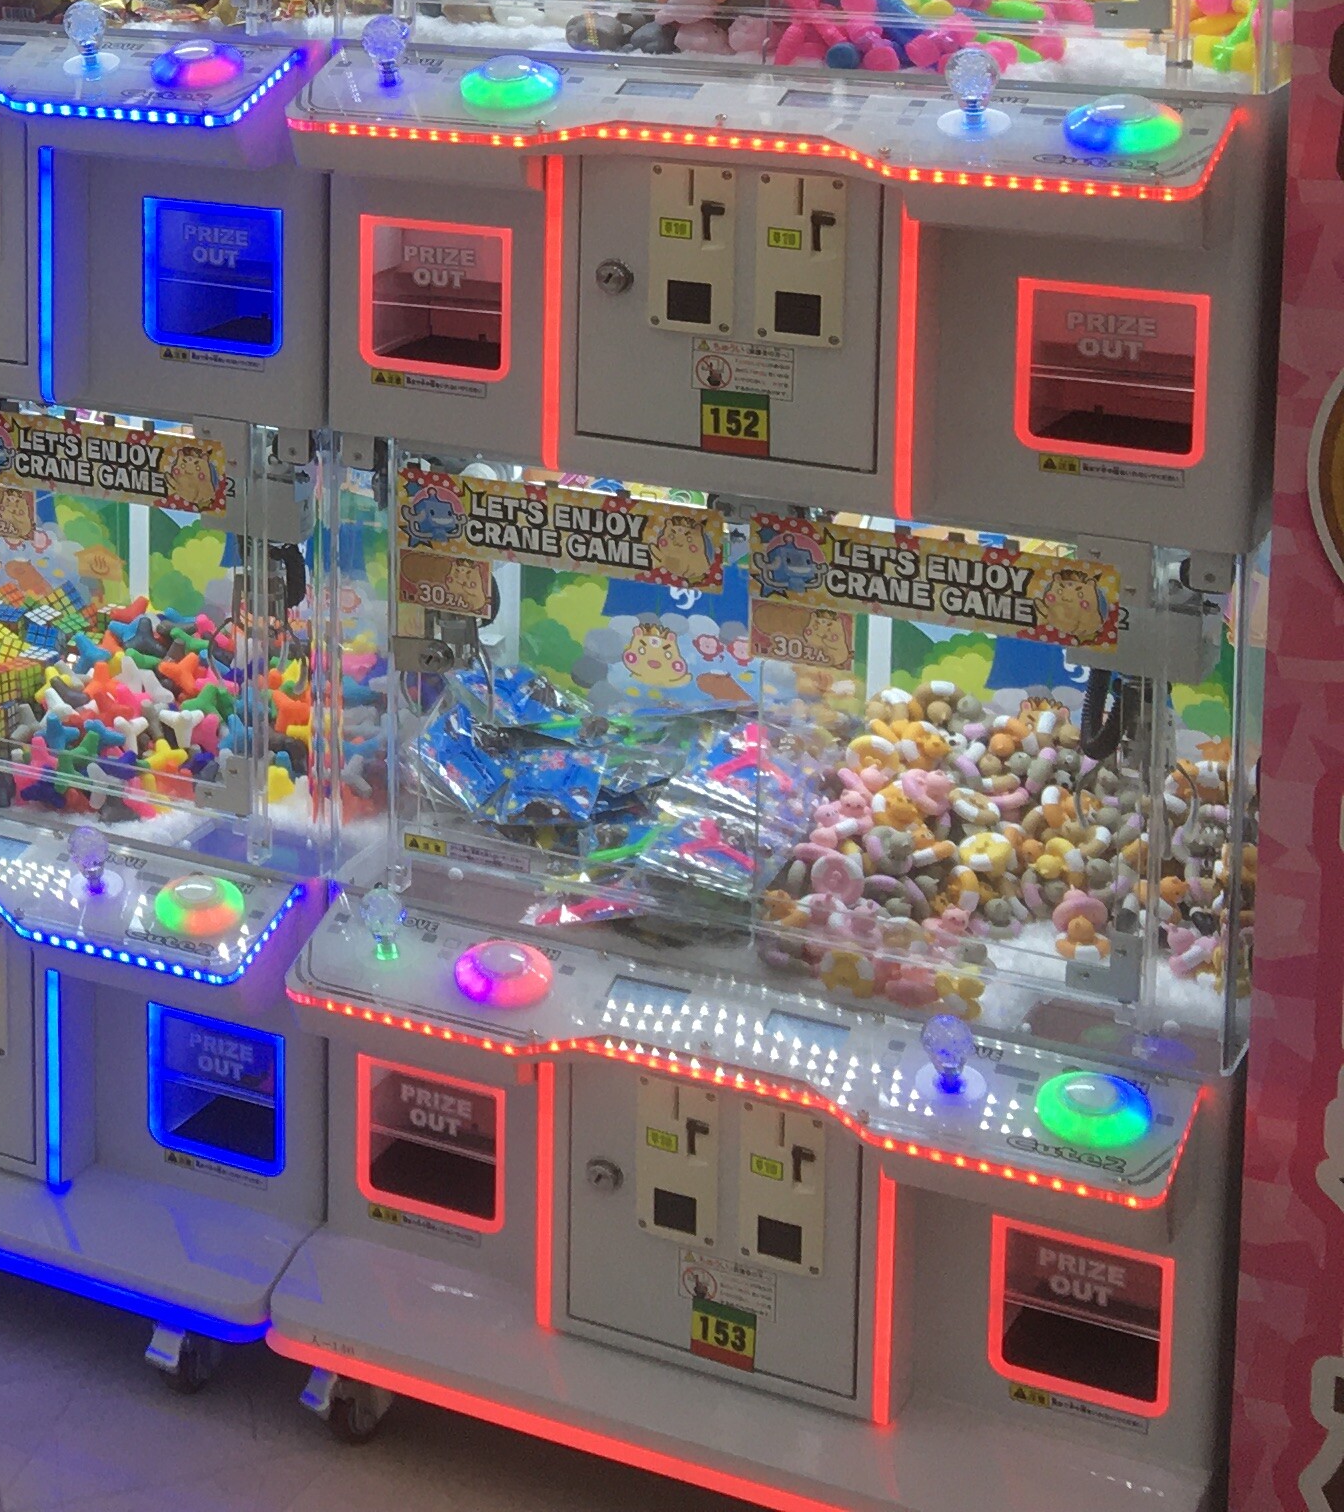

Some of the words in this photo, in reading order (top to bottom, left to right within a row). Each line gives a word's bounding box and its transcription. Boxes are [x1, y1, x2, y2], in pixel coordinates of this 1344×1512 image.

[184, 225, 248, 248] PRIZE
[192, 246, 239, 269] OUT
[402, 245, 475, 268] PRIZE
[413, 267, 465, 290] OUT
[1066, 312, 1157, 338] PRIZE
[1077, 338, 1144, 361] OUT
[708, 410, 761, 440] 152
[472, 491, 544, 526] LET'S
[554, 502, 645, 539] ENJOY
[465, 517, 559, 554] CRANE
[566, 531, 651, 568] GAME
[833, 539, 916, 578] LET'S
[927, 552, 1030, 593] ENJOY
[825, 566, 932, 608] CRANE
[940, 583, 1035, 624] GAME
[400, 1083, 475, 1116] PRIZE
[409, 1106, 464, 1139] OUT
[1037, 1245, 1126, 1285] PRIZE
[1048, 1273, 1114, 1308] OUT
[695, 1316, 749, 1353] 153
